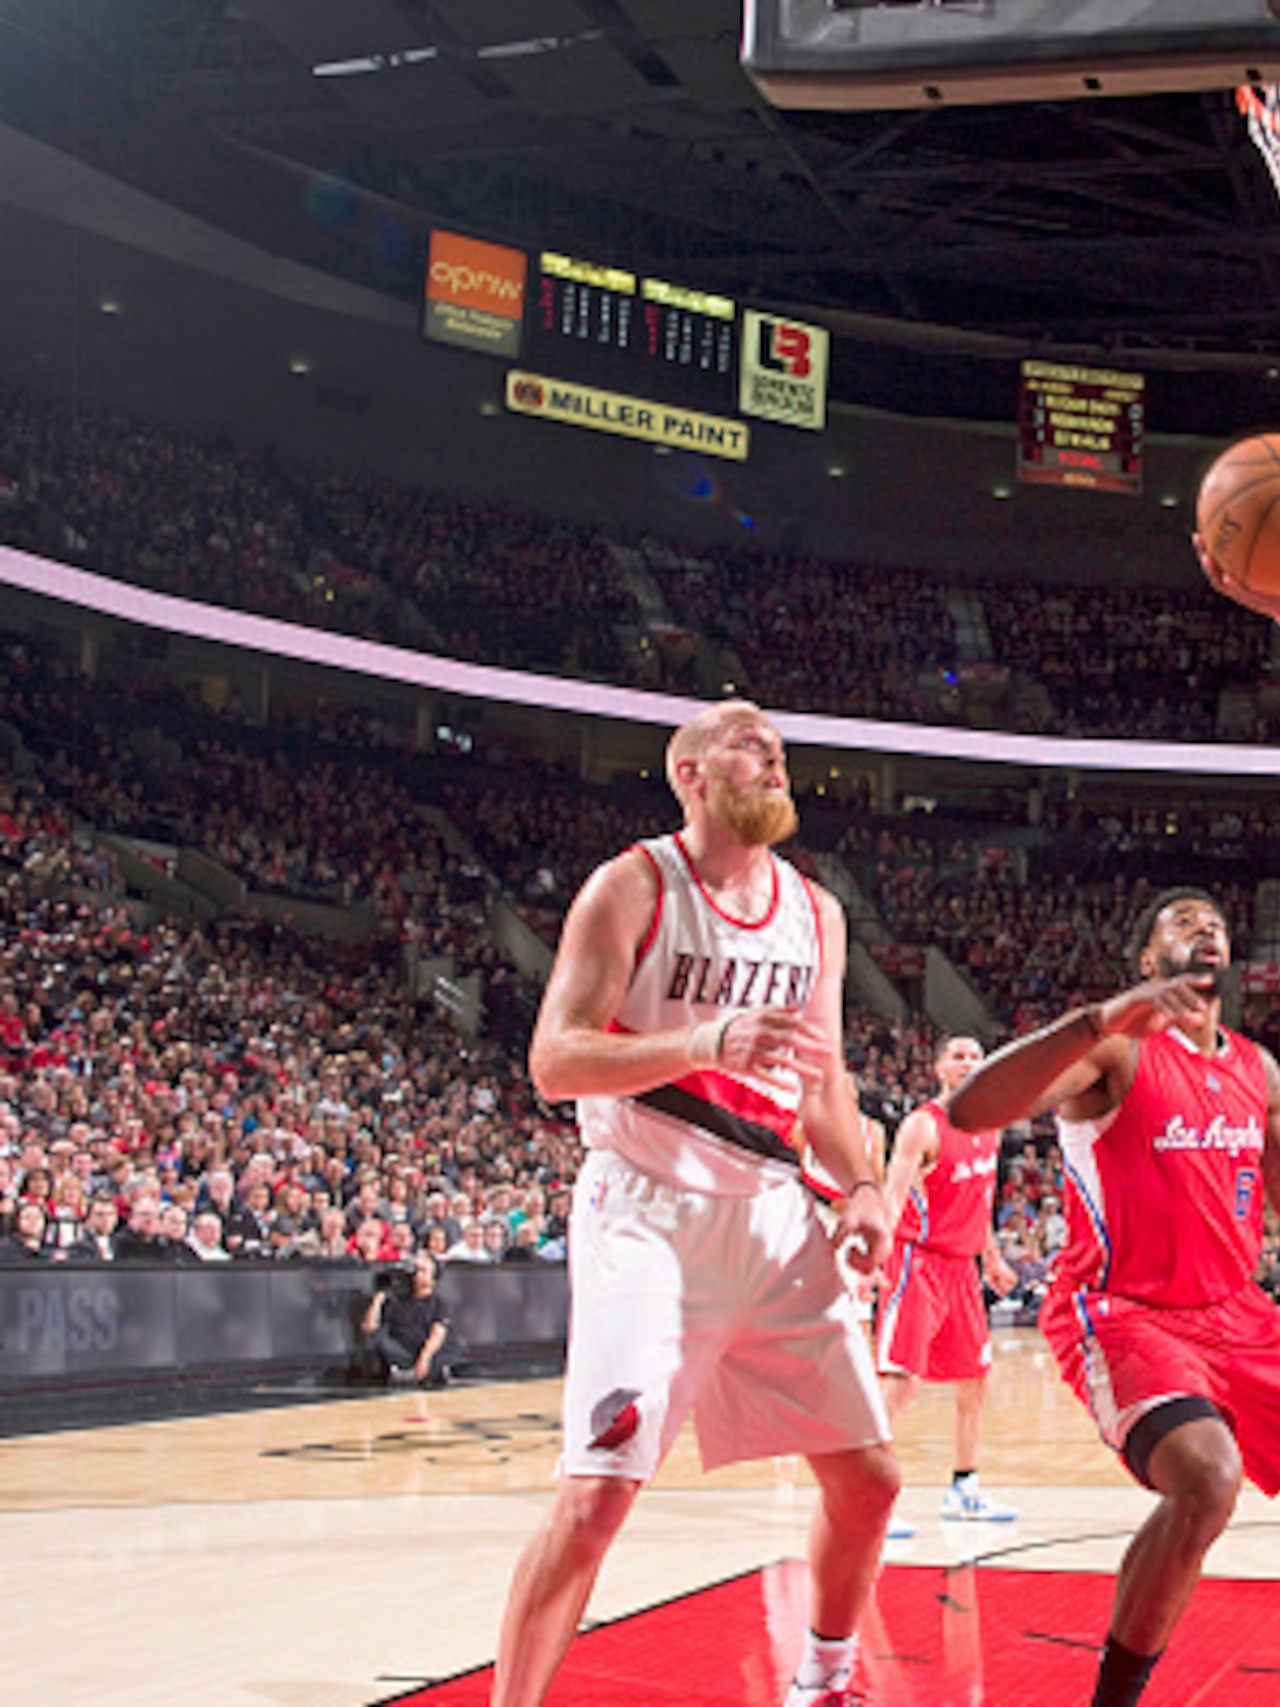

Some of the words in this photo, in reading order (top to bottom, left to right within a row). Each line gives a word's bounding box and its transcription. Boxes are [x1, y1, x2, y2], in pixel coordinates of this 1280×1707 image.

[550, 387, 654, 432] MILLER
[663, 413, 743, 450] PAINT
[1152, 1114, 1202, 1152] Los
[17, 1288, 118, 1351] PASS
